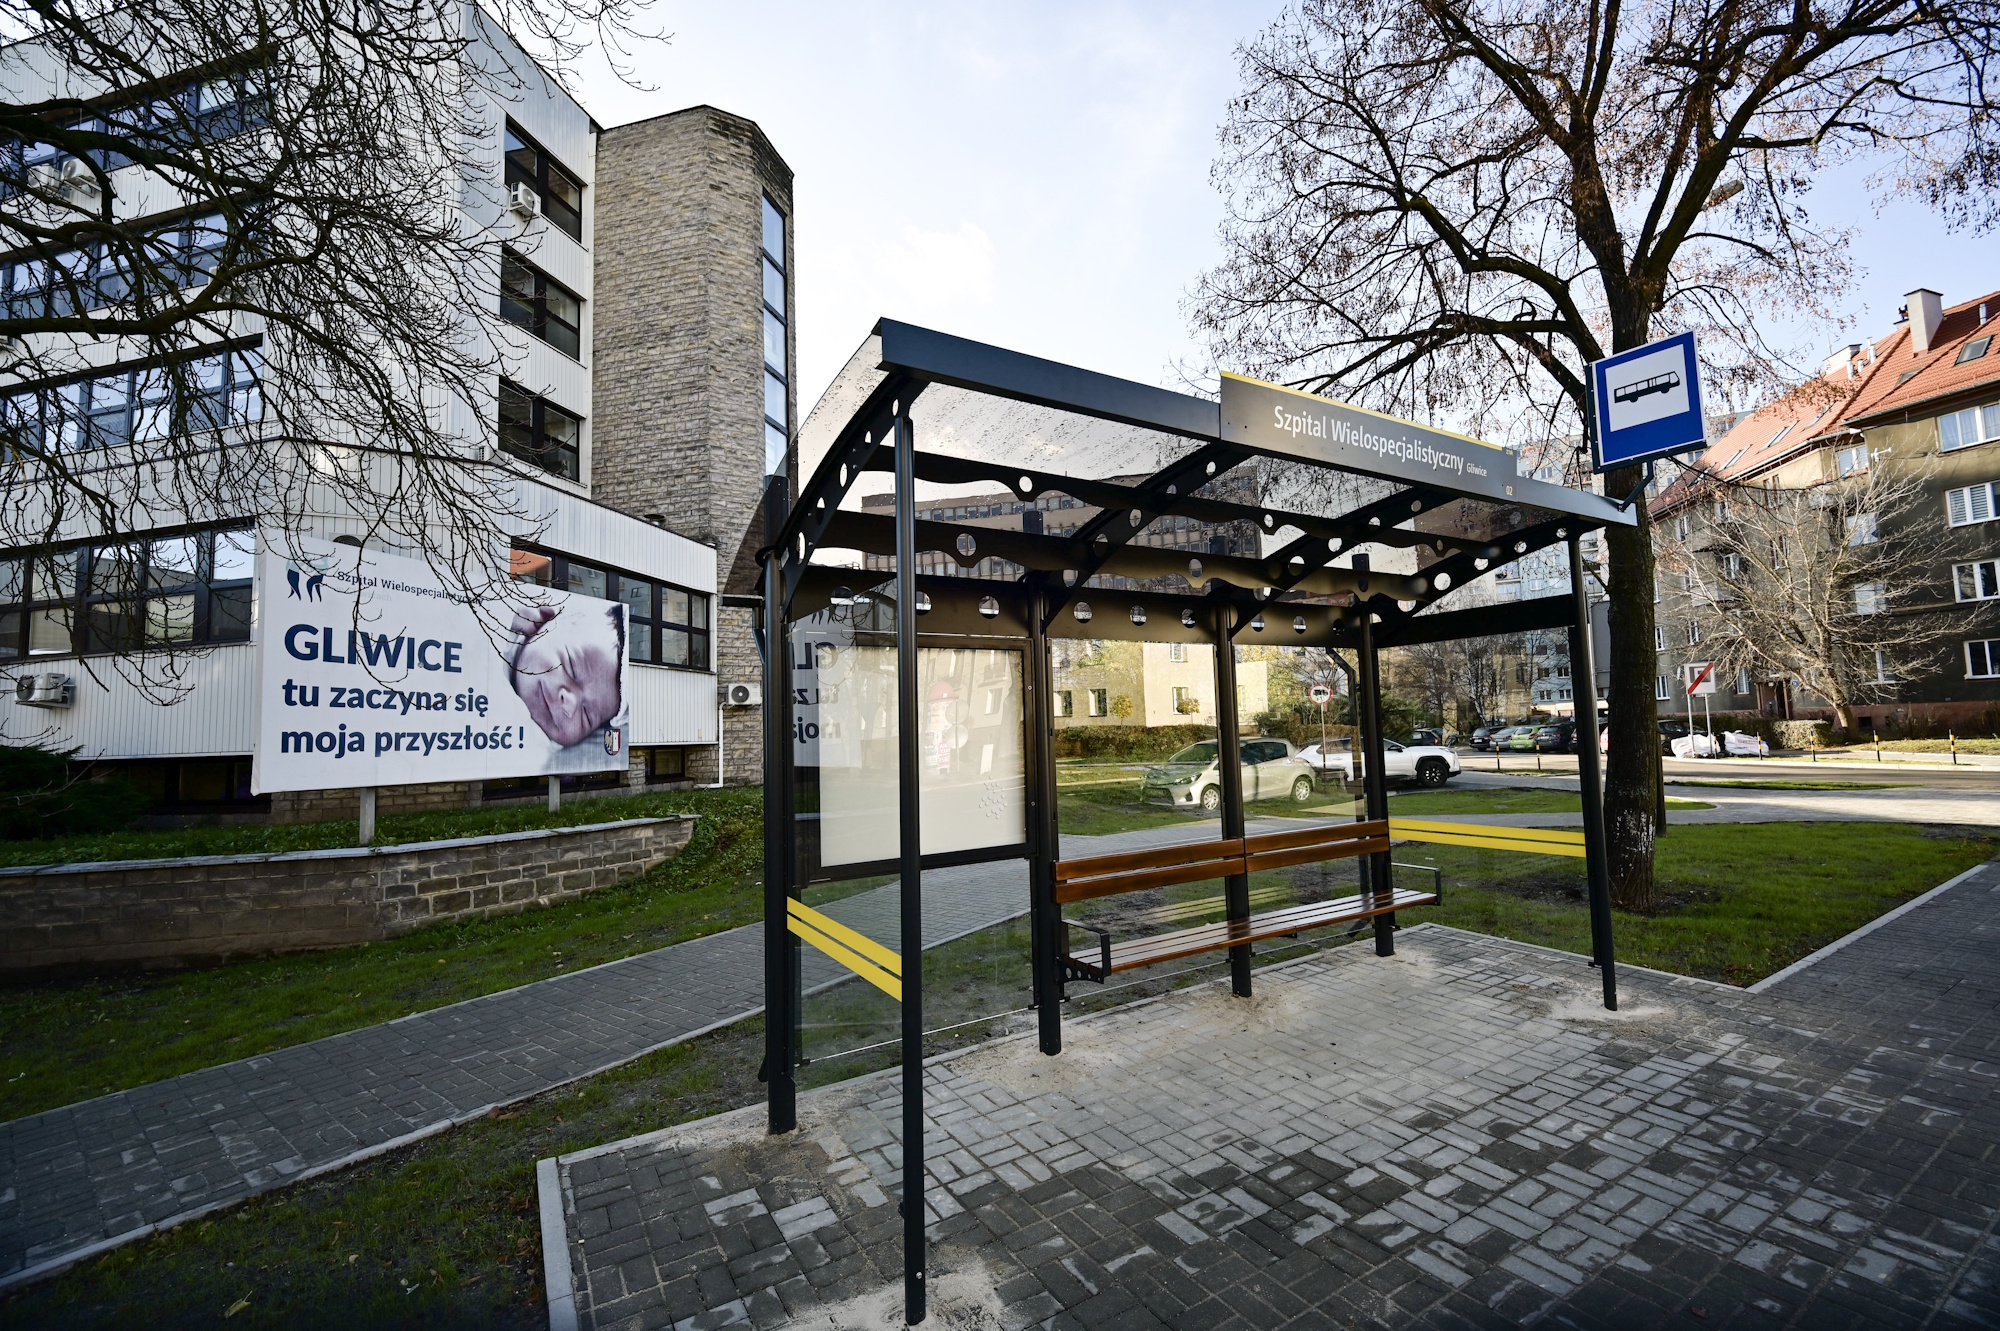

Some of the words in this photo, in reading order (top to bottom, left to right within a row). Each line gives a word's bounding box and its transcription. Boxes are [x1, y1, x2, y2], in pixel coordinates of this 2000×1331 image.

[1274, 405, 1327, 438] Szpital
[1331, 419, 1464, 476] Wielospecjalistyczny
[1466, 463, 1488, 477] Gliwice
[1506, 486, 1513, 496] 02
[337, 571, 377, 587] Szpital
[284, 623, 463, 673] GLIWICE
[282, 678, 319, 707] tu
[329, 686, 448, 716] zaczyna
[454, 687, 489, 718] się
[281, 723, 365, 758] moja
[375, 725, 513, 757] przyszłość
